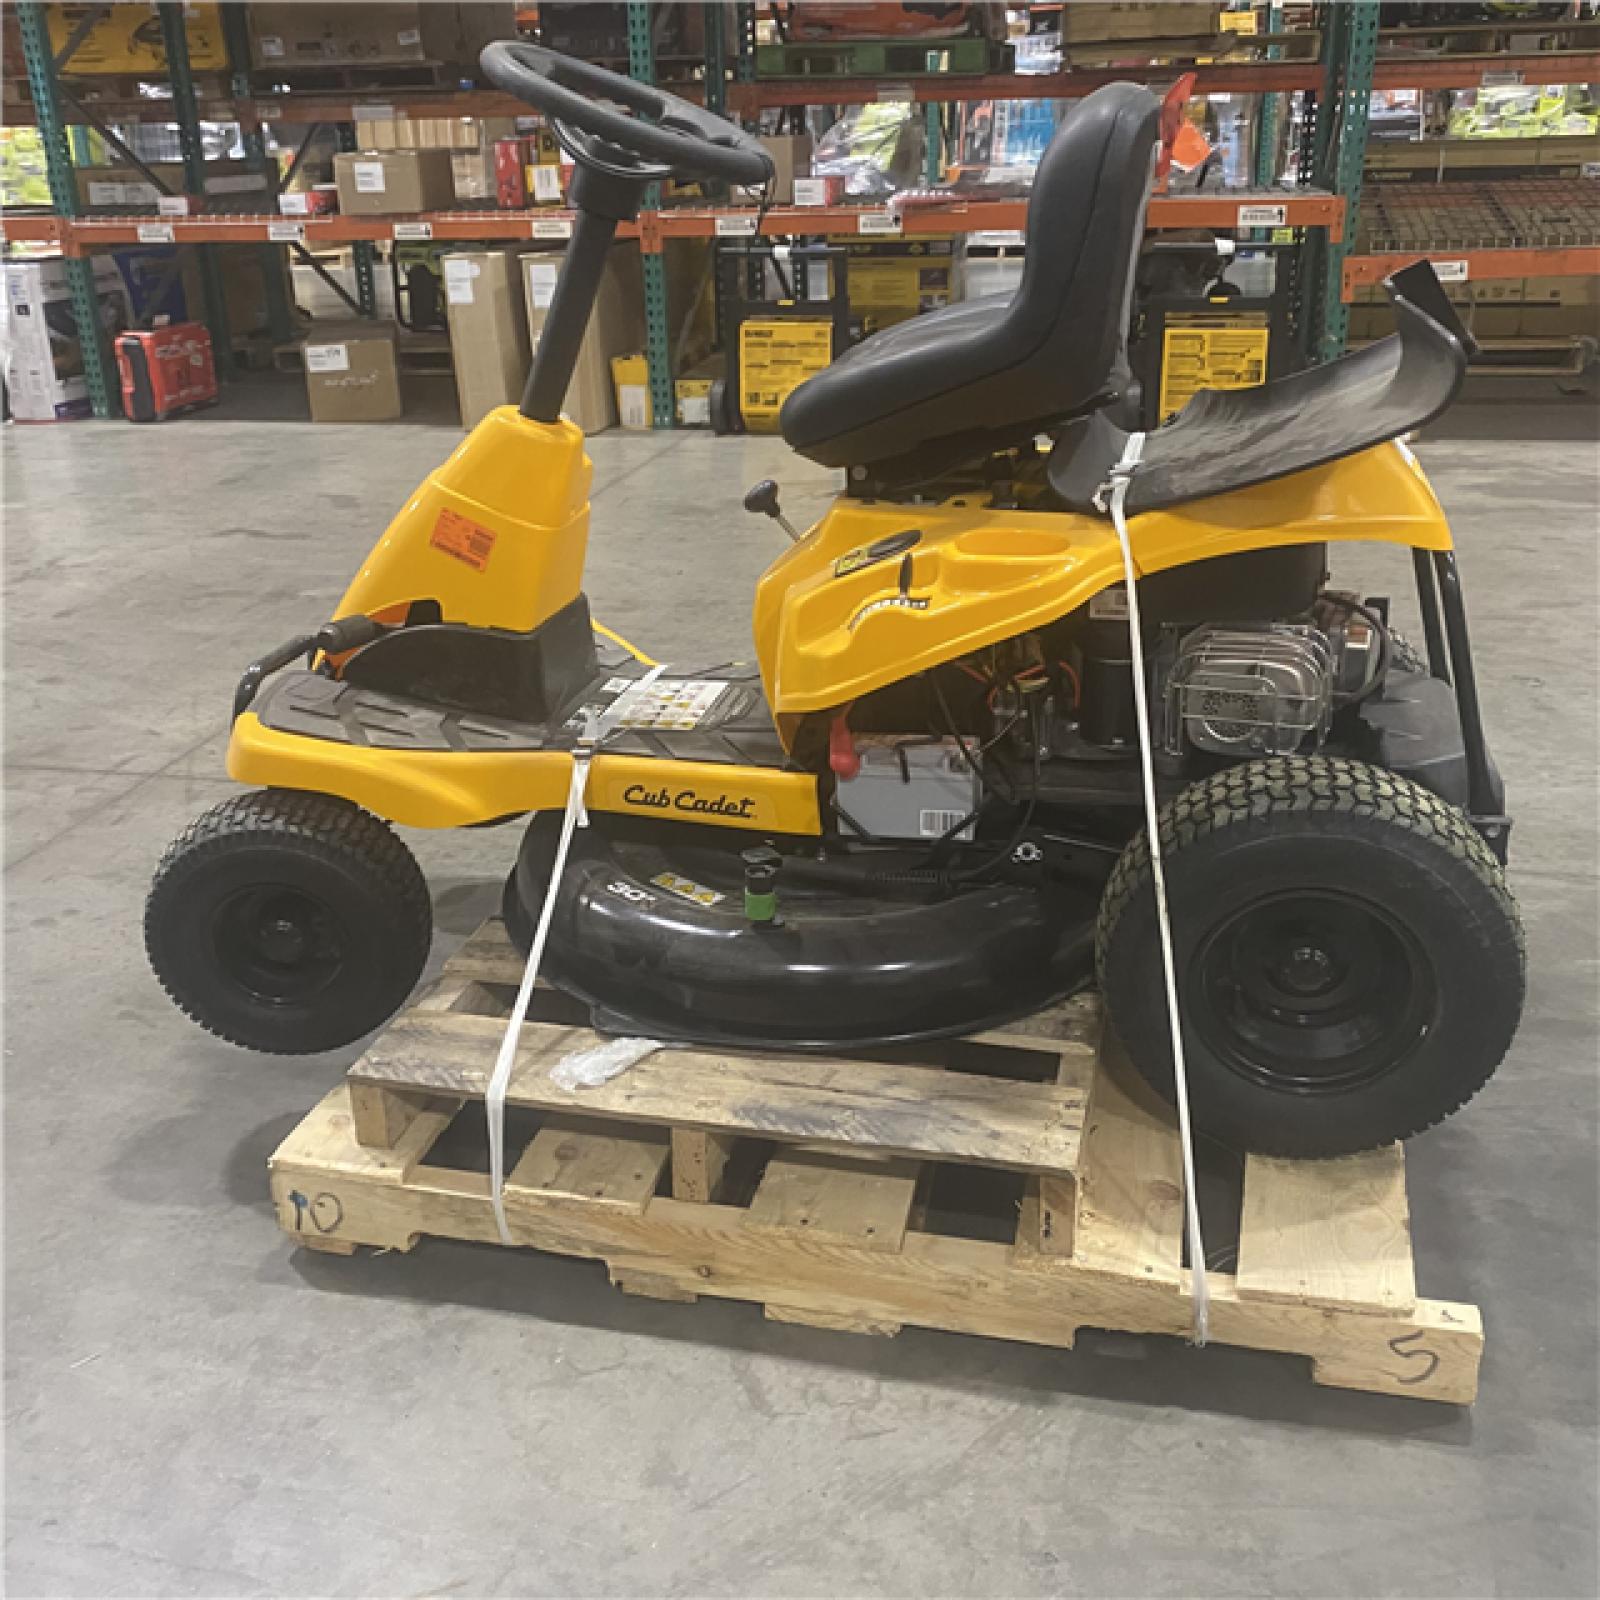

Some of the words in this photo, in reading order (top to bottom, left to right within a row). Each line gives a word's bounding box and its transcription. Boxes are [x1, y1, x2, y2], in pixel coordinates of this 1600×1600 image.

[623, 784, 671, 808] Cub
[674, 789, 757, 819] Cadet
[1386, 1329, 1439, 1385] 5
